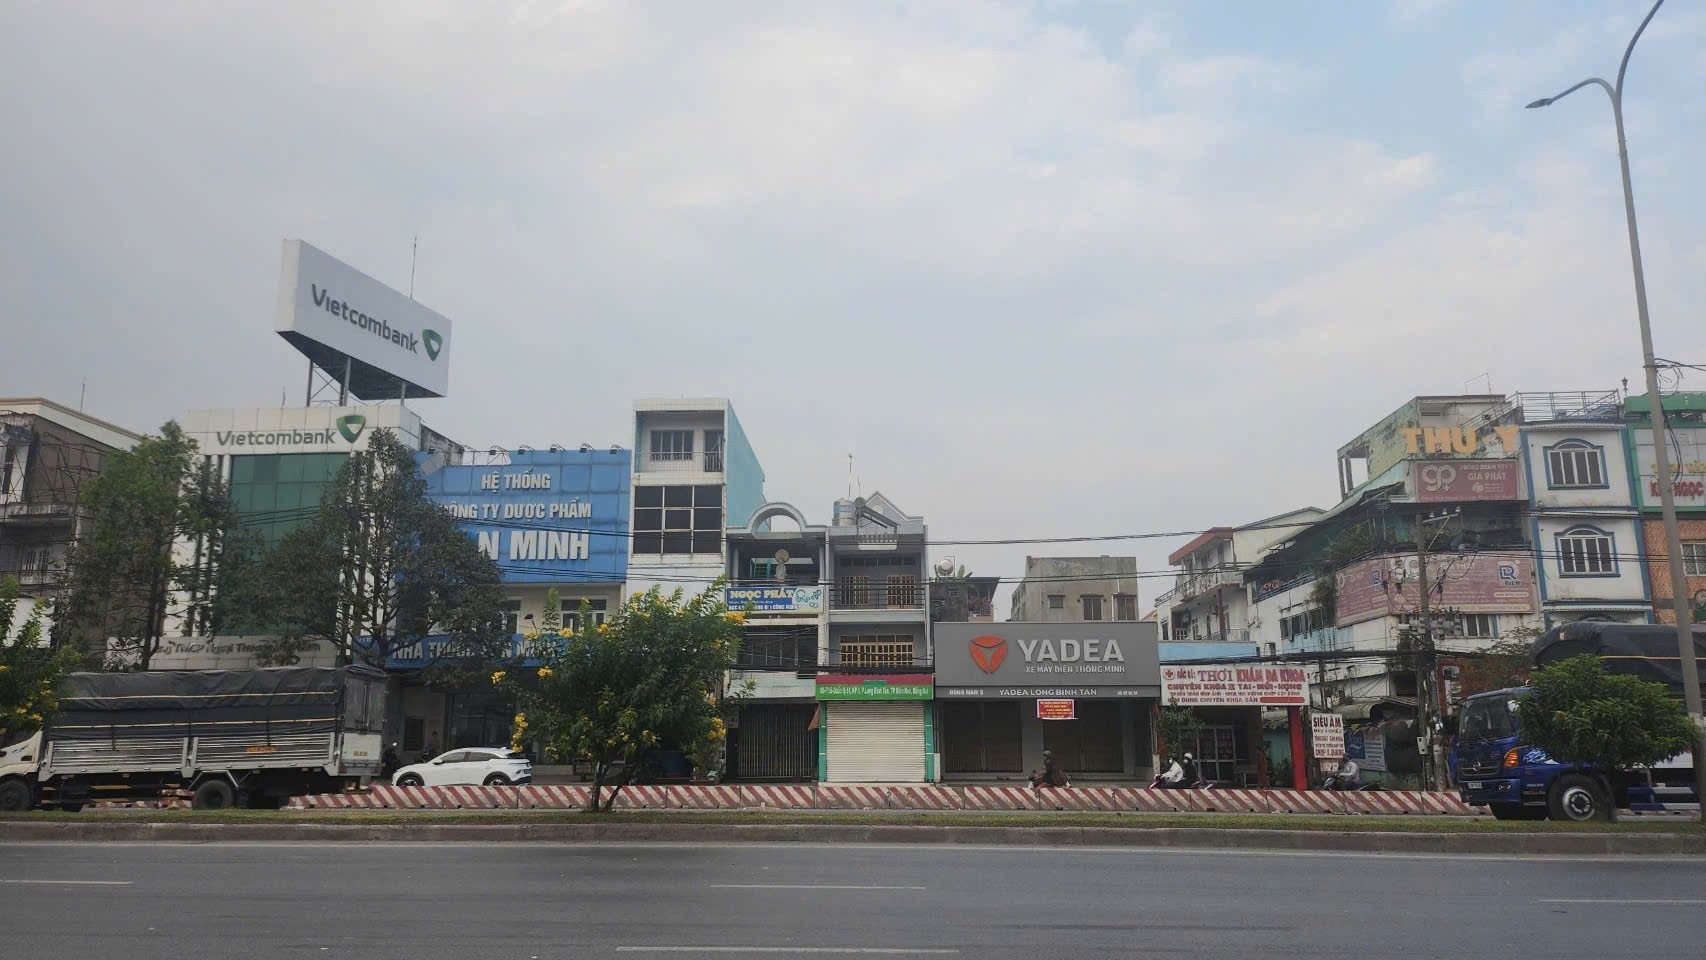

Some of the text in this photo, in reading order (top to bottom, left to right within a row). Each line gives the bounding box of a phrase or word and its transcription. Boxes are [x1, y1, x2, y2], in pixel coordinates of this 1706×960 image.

[311, 283, 418, 354] Vietcombank
[216, 428, 336, 446] Vietcombank
[481, 468, 550, 493] HỆ THỐNG
[446, 497, 592, 522] ÔNG TY DƯỢC PHẨM
[510, 530, 589, 560] MINH
[730, 590, 761, 600] NGỌC
[1016, 639, 1124, 662] YADEA
[1104, 665, 1125, 673] MINH
[1236, 667, 1263, 682] KHÁM
[1280, 669, 1306, 682] KHOA
[1168, 682, 1201, 690] CHUYÊN
[1313, 715, 1342, 727] SIÊU ÂM
